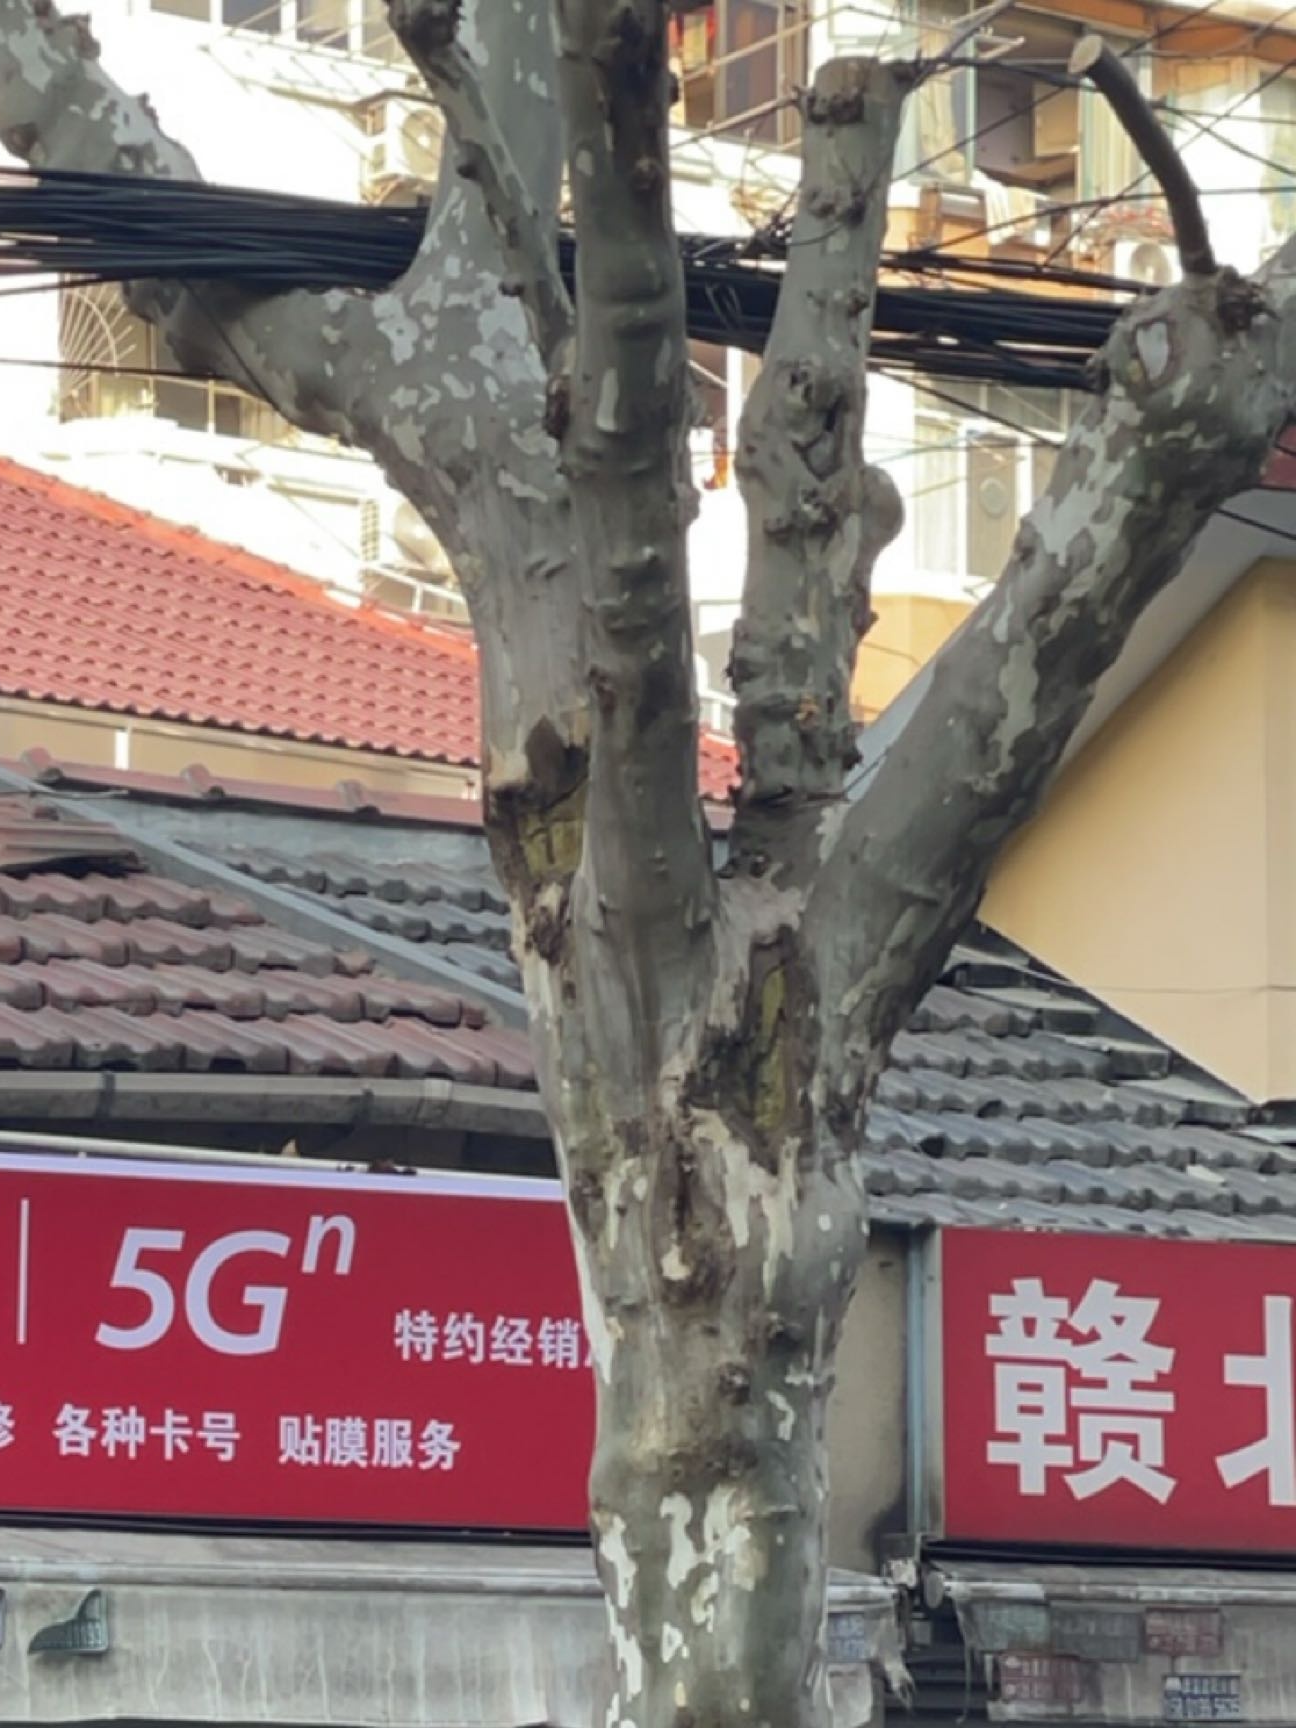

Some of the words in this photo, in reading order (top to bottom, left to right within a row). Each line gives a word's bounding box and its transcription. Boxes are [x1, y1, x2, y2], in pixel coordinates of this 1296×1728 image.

[393, 1308, 593, 1370] 特约经销
[53, 1403, 241, 1462] 各种卡号
[277, 1415, 461, 1471] 贴膜服务
